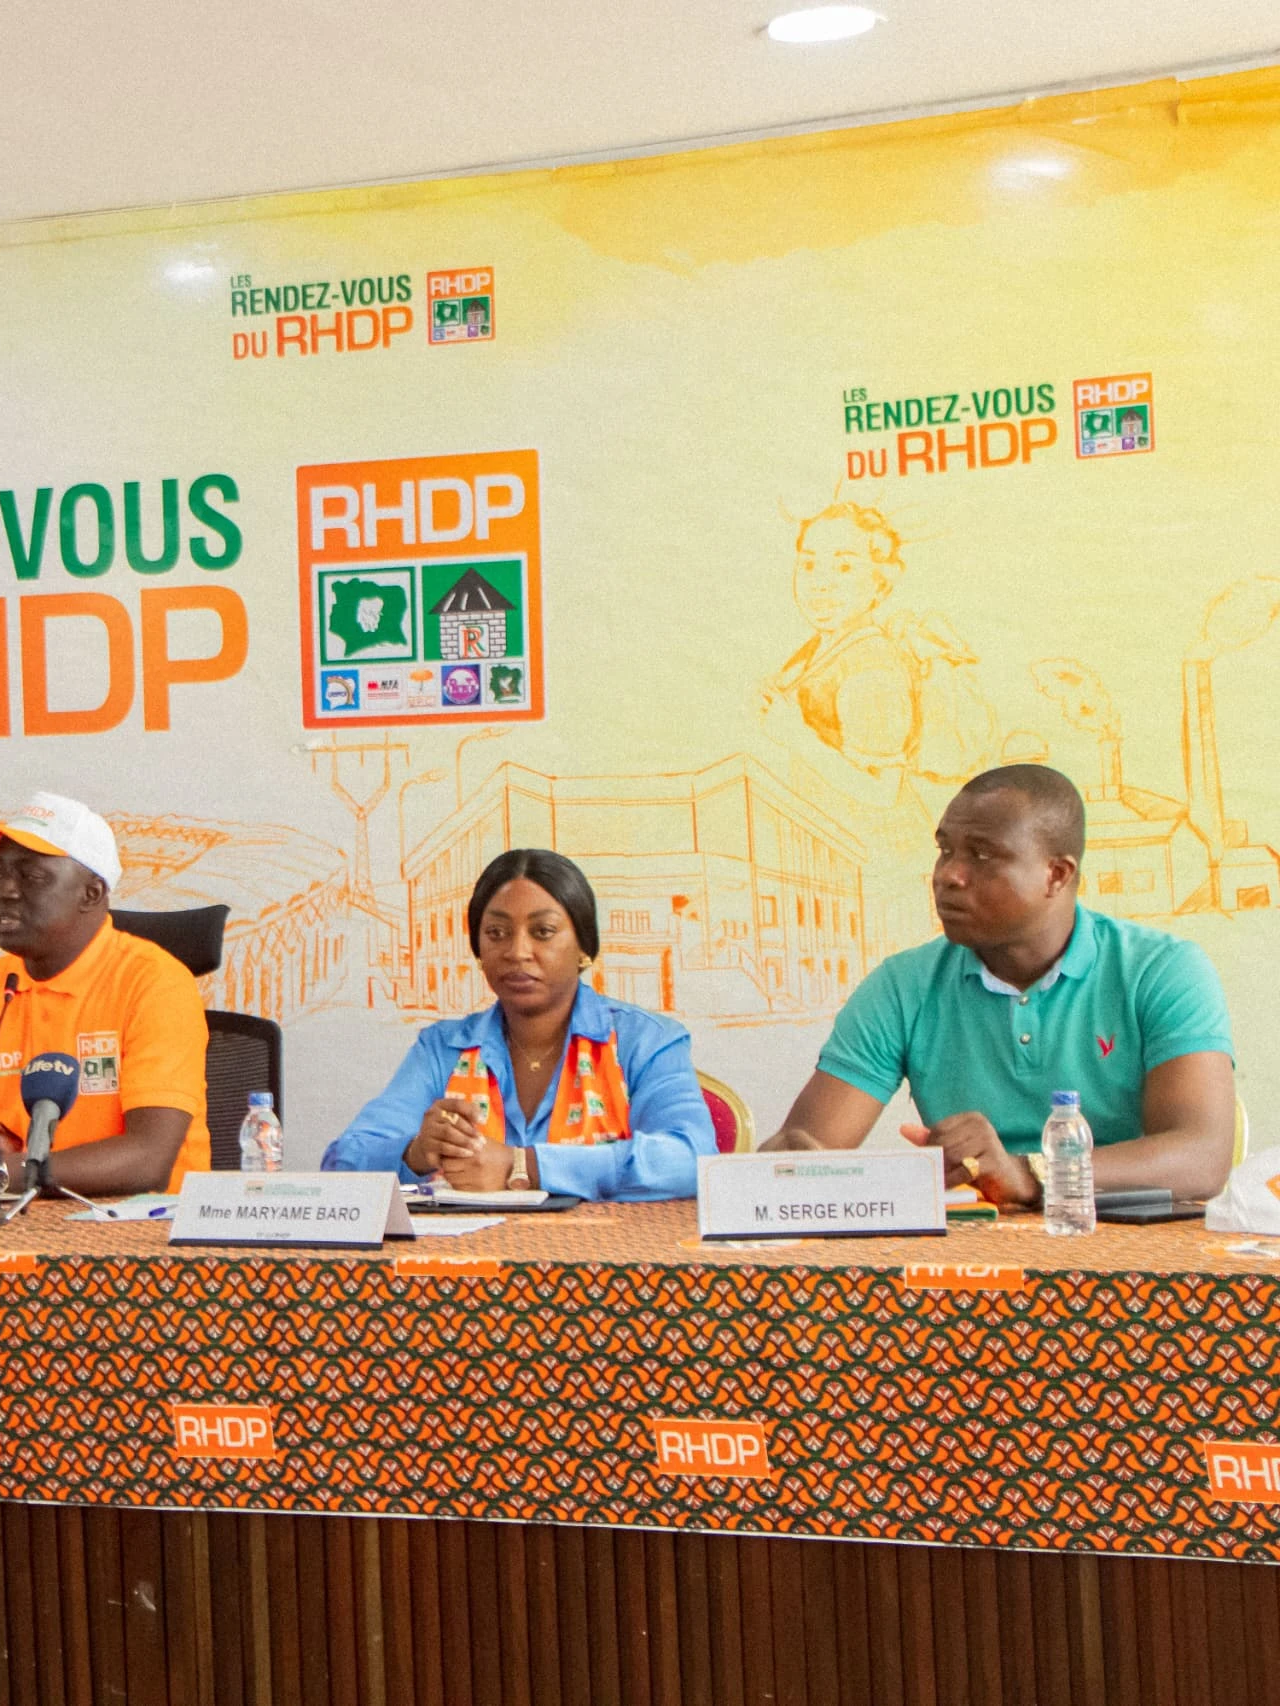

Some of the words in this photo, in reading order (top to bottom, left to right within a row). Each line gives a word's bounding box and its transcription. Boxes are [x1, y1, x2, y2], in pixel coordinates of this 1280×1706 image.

[231, 275, 251, 288] LES
[231, 275, 412, 317] RENDEZ-VOUS
[431, 272, 490, 296] RHDP
[233, 331, 268, 360] DU
[276, 306, 414, 358] RHDP
[843, 388, 867, 403] LES
[1077, 378, 1148, 405] RHDP
[844, 383, 1056, 434] RENDEZ-VOUS
[847, 449, 887, 480] DU
[897, 417, 1058, 477] RHDP
[310, 474, 526, 551] RHDP
[199, 1205, 231, 1220] Mme
[236, 1205, 310, 1221] MARYAME
[316, 1206, 361, 1222] BARO
[755, 1206, 773, 1221] M.
[779, 1203, 838, 1220] SERGE
[844, 1201, 895, 1218] KOFFI
[179, 1415, 267, 1448] RHDP
[660, 1430, 760, 1466] RHDP
